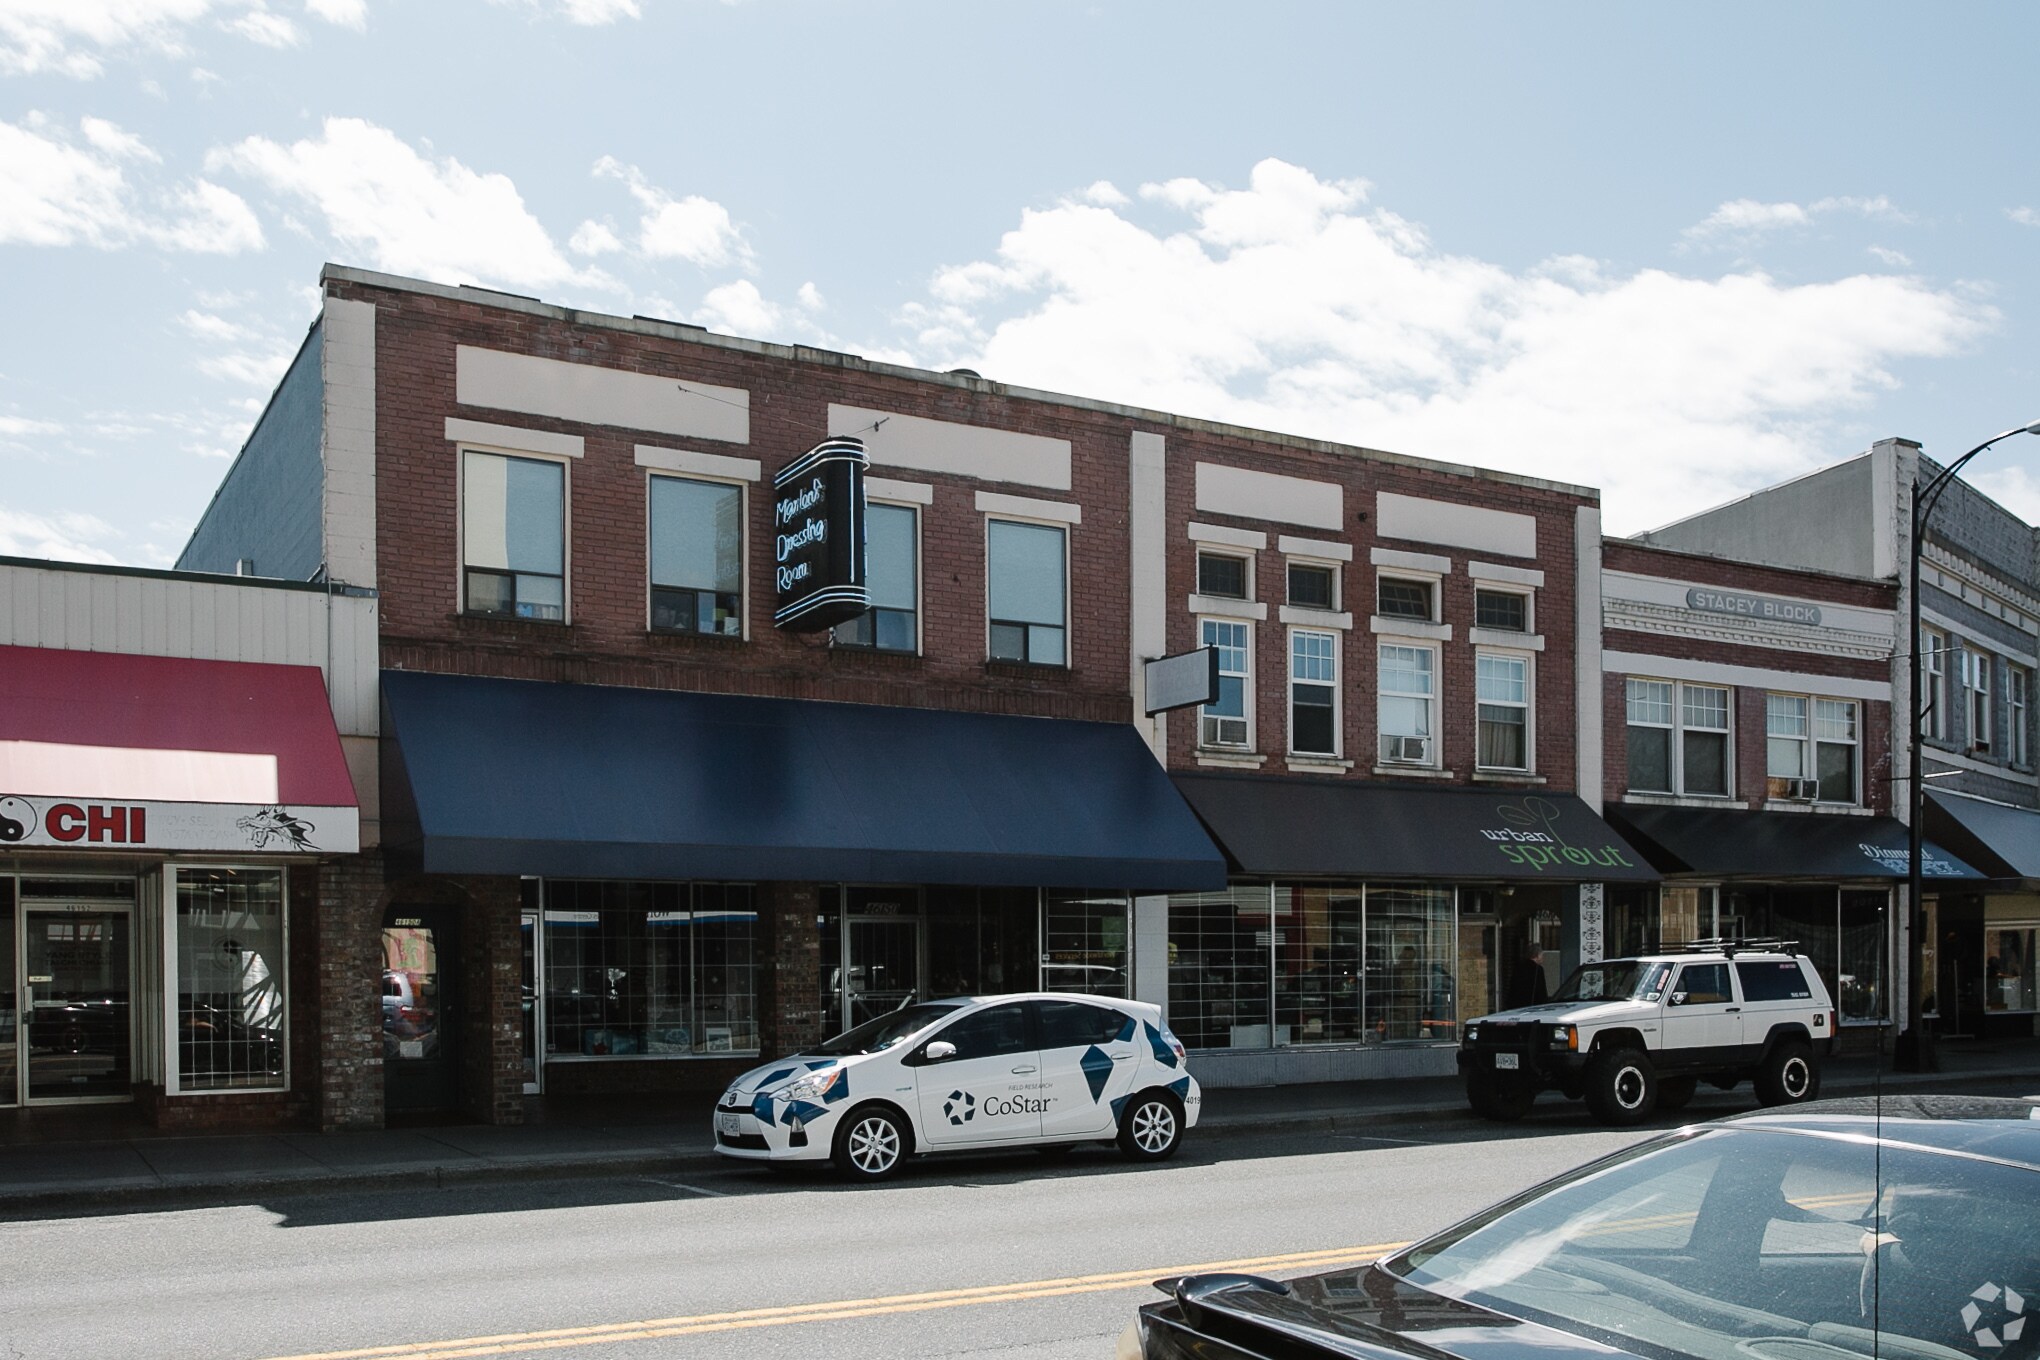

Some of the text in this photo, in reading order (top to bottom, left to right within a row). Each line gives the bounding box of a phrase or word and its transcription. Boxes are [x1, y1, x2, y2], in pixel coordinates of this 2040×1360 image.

[776, 517, 825, 562] Dressing
[777, 562, 808, 594] Room
[1695, 592, 1816, 622] STACEY BLOCK
[45, 803, 146, 843] CHI
[1479, 827, 1554, 843] urban
[1498, 845, 1634, 871] sprout
[1858, 843, 1934, 861] Diamd
[1026, 1083, 1053, 1091] RESEARCH
[983, 1095, 1052, 1116] CoStar
[1186, 1096, 1201, 1105] 4019
